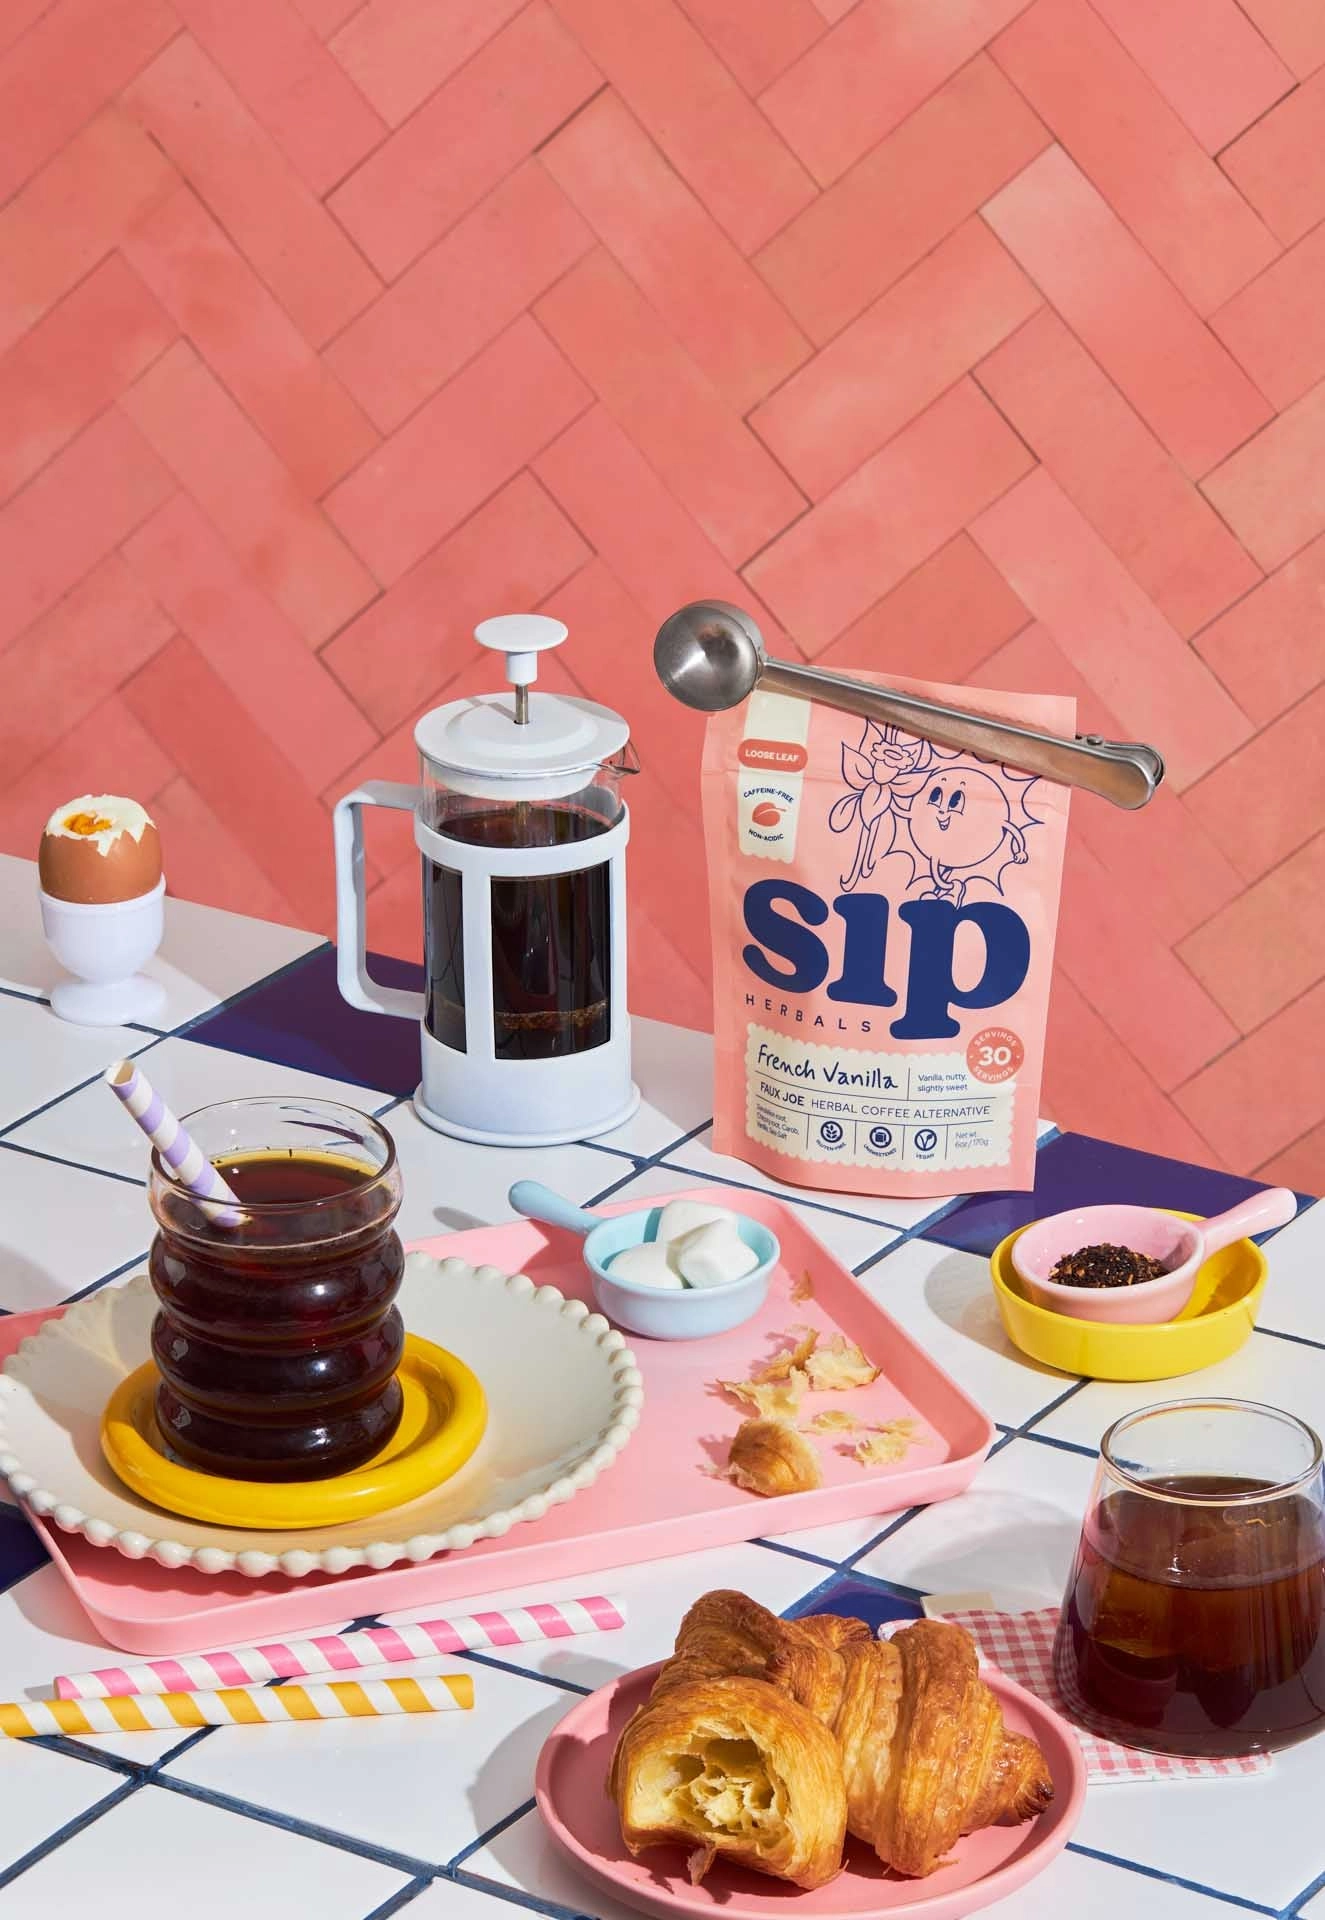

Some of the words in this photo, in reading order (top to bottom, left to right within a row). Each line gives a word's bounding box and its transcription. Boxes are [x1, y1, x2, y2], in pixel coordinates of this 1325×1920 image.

[744, 748, 775, 760] LOOSE
[776, 752, 800, 762] LEAF
[743, 787, 795, 803] CAFFEINE-FREE
[748, 828, 785, 841] NON-ACIDIC
[743, 879, 1031, 1040] sip
[745, 993, 872, 1033] HERBALS
[974, 1030, 1017, 1048] SERVINGS
[979, 1045, 1012, 1067] 30
[757, 1044, 816, 1081] French
[823, 1061, 899, 1090] Vanilla
[973, 1064, 1015, 1081] SERVINGS
[760, 1081, 781, 1099] FAUX
[781, 1091, 805, 1107] JOE
[917, 1083, 944, 1093] slightly
[945, 1083, 968, 1092] sweet
[811, 1098, 858, 1114] HERBAL
[861, 1104, 911, 1119] COFFEE
[913, 1105, 991, 1119] ALTERNATIVE
